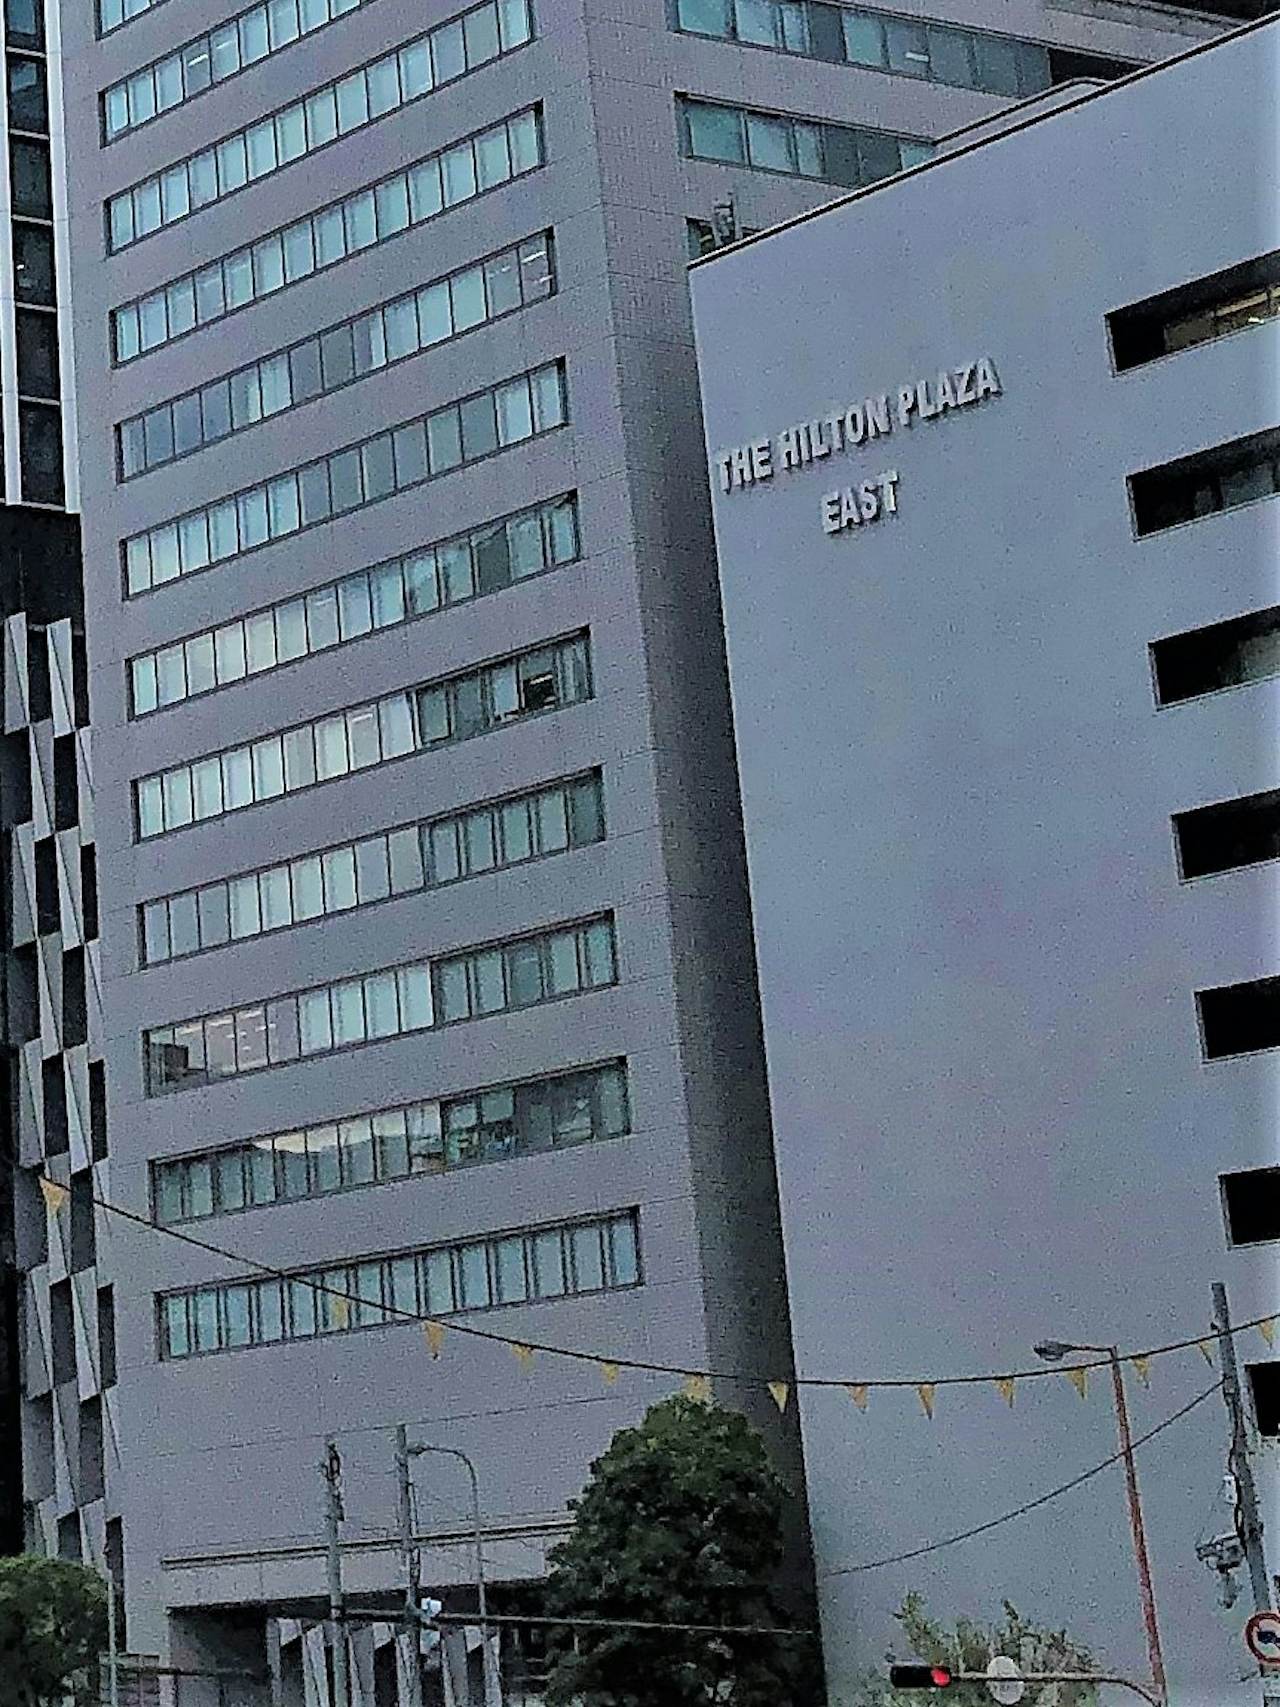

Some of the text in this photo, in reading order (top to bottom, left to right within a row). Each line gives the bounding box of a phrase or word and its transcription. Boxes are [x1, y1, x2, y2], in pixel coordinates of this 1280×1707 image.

[717, 356, 1003, 492] THE HILTON PLAZA
[821, 471, 899, 533] EAST
